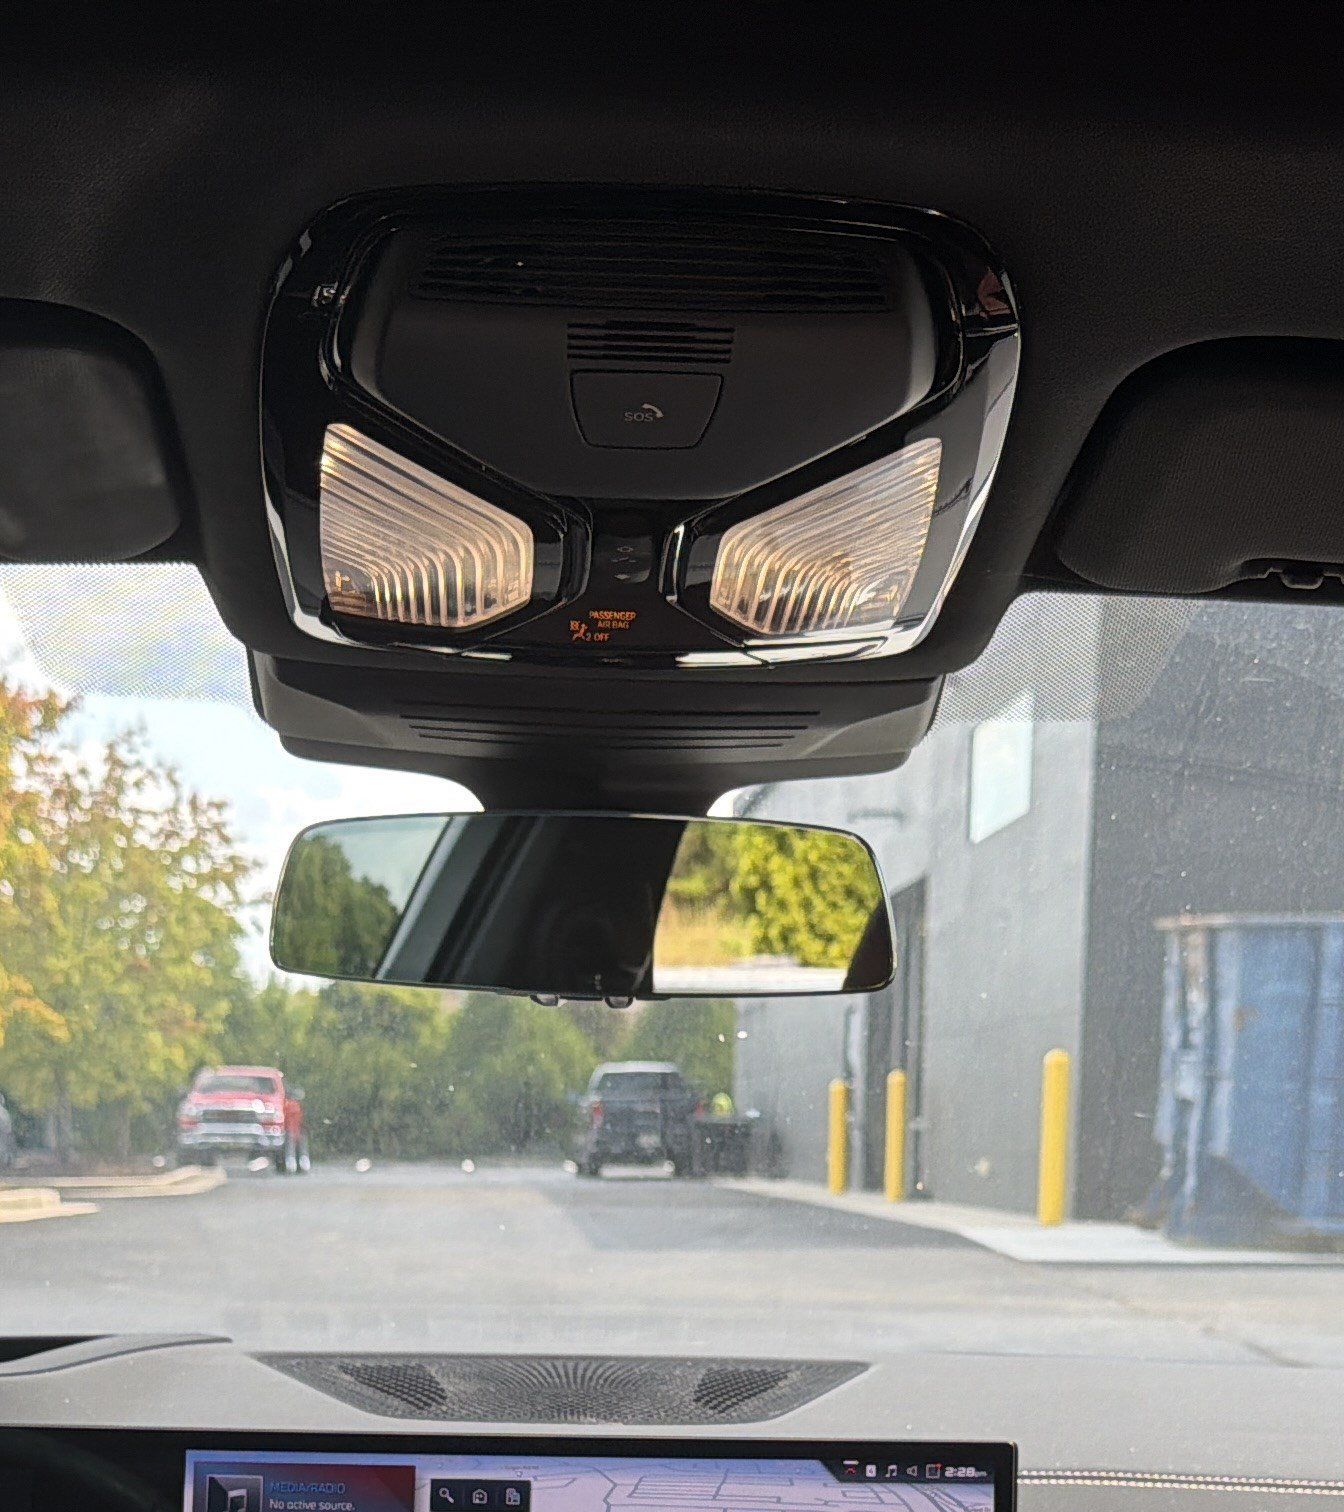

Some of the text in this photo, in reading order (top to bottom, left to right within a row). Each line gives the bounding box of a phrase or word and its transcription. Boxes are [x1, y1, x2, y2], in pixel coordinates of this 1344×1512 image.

[624, 411, 654, 421] SOS
[589, 610, 636, 620] PASSENGER
[597, 620, 630, 629] AIR BAG
[594, 632, 610, 641] OFF
[269, 1498, 356, 1511] No active source.
